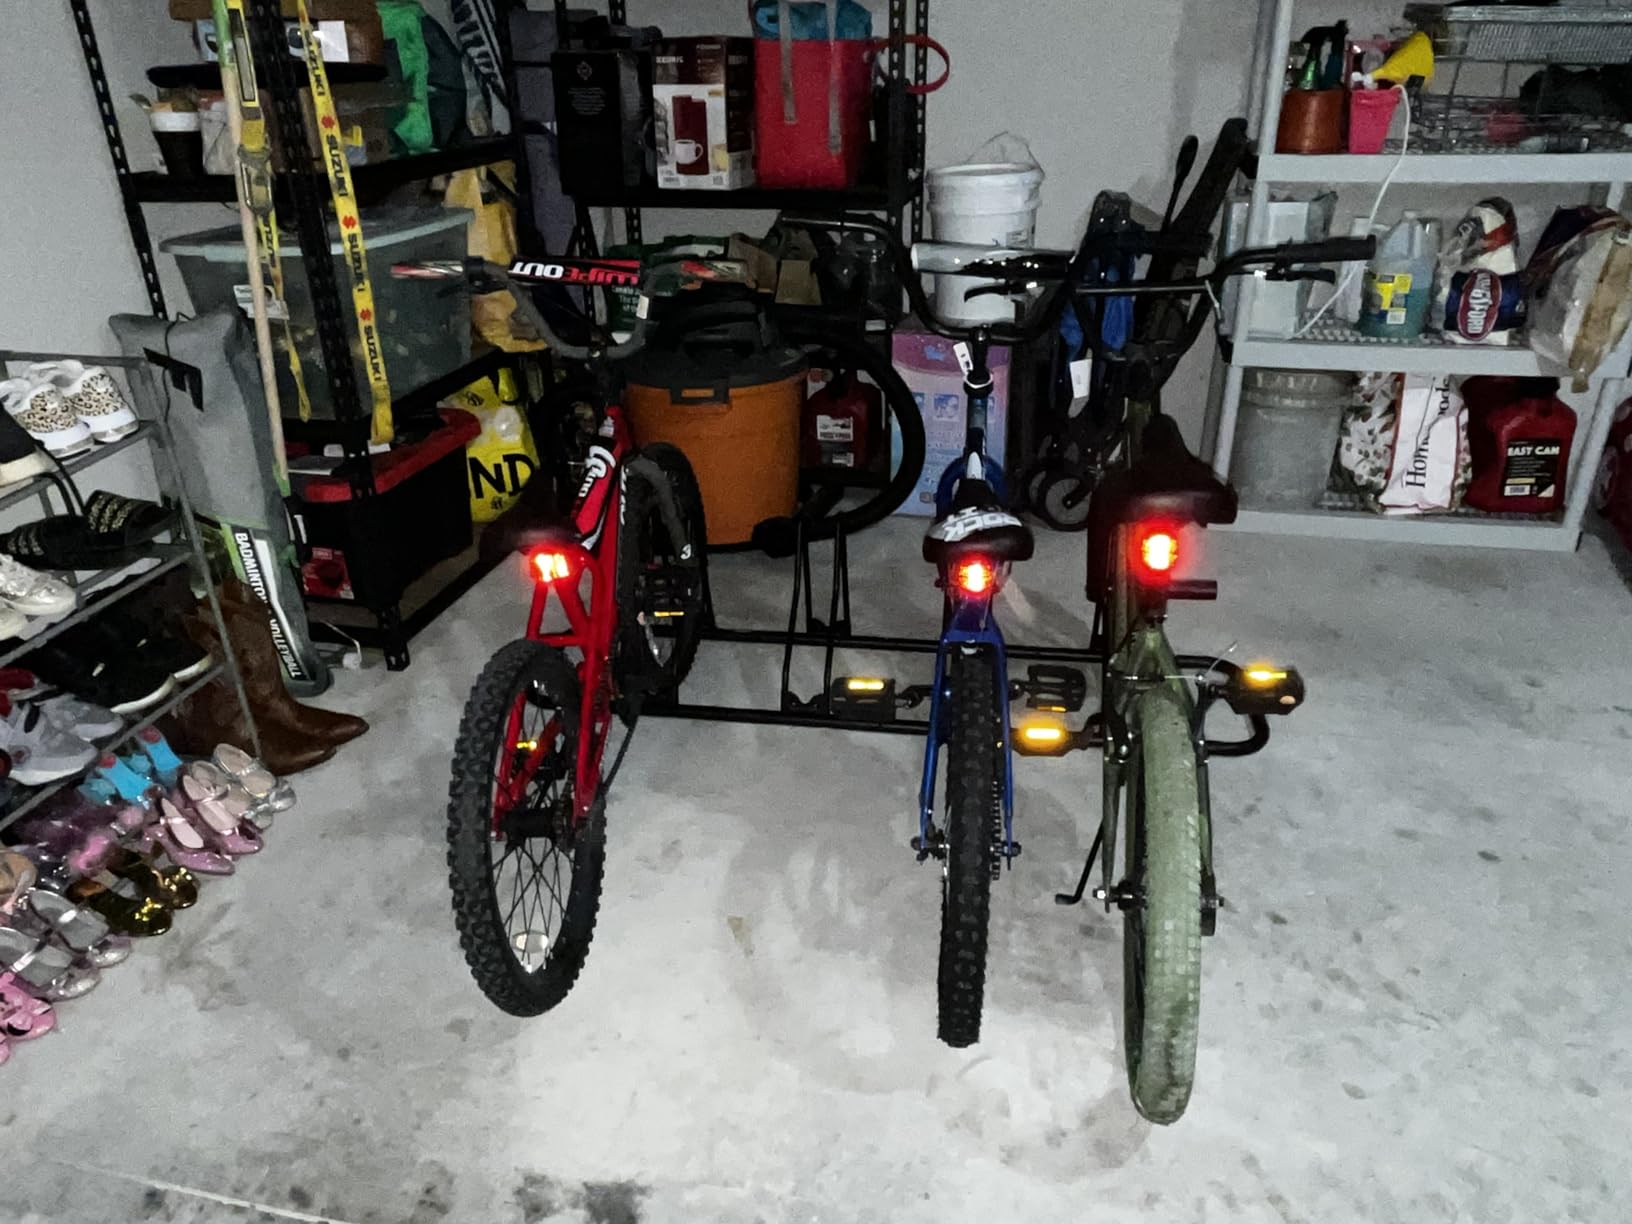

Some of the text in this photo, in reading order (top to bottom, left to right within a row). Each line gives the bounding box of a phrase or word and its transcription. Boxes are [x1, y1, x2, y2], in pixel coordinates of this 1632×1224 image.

[326, 133, 349, 197] SUZUKI
[347, 233, 366, 292] SUZUKI
[364, 325, 382, 381] SUZUKI
[1507, 445, 1560, 457] EASY CAN
[235, 532, 269, 604] BADMINTO
